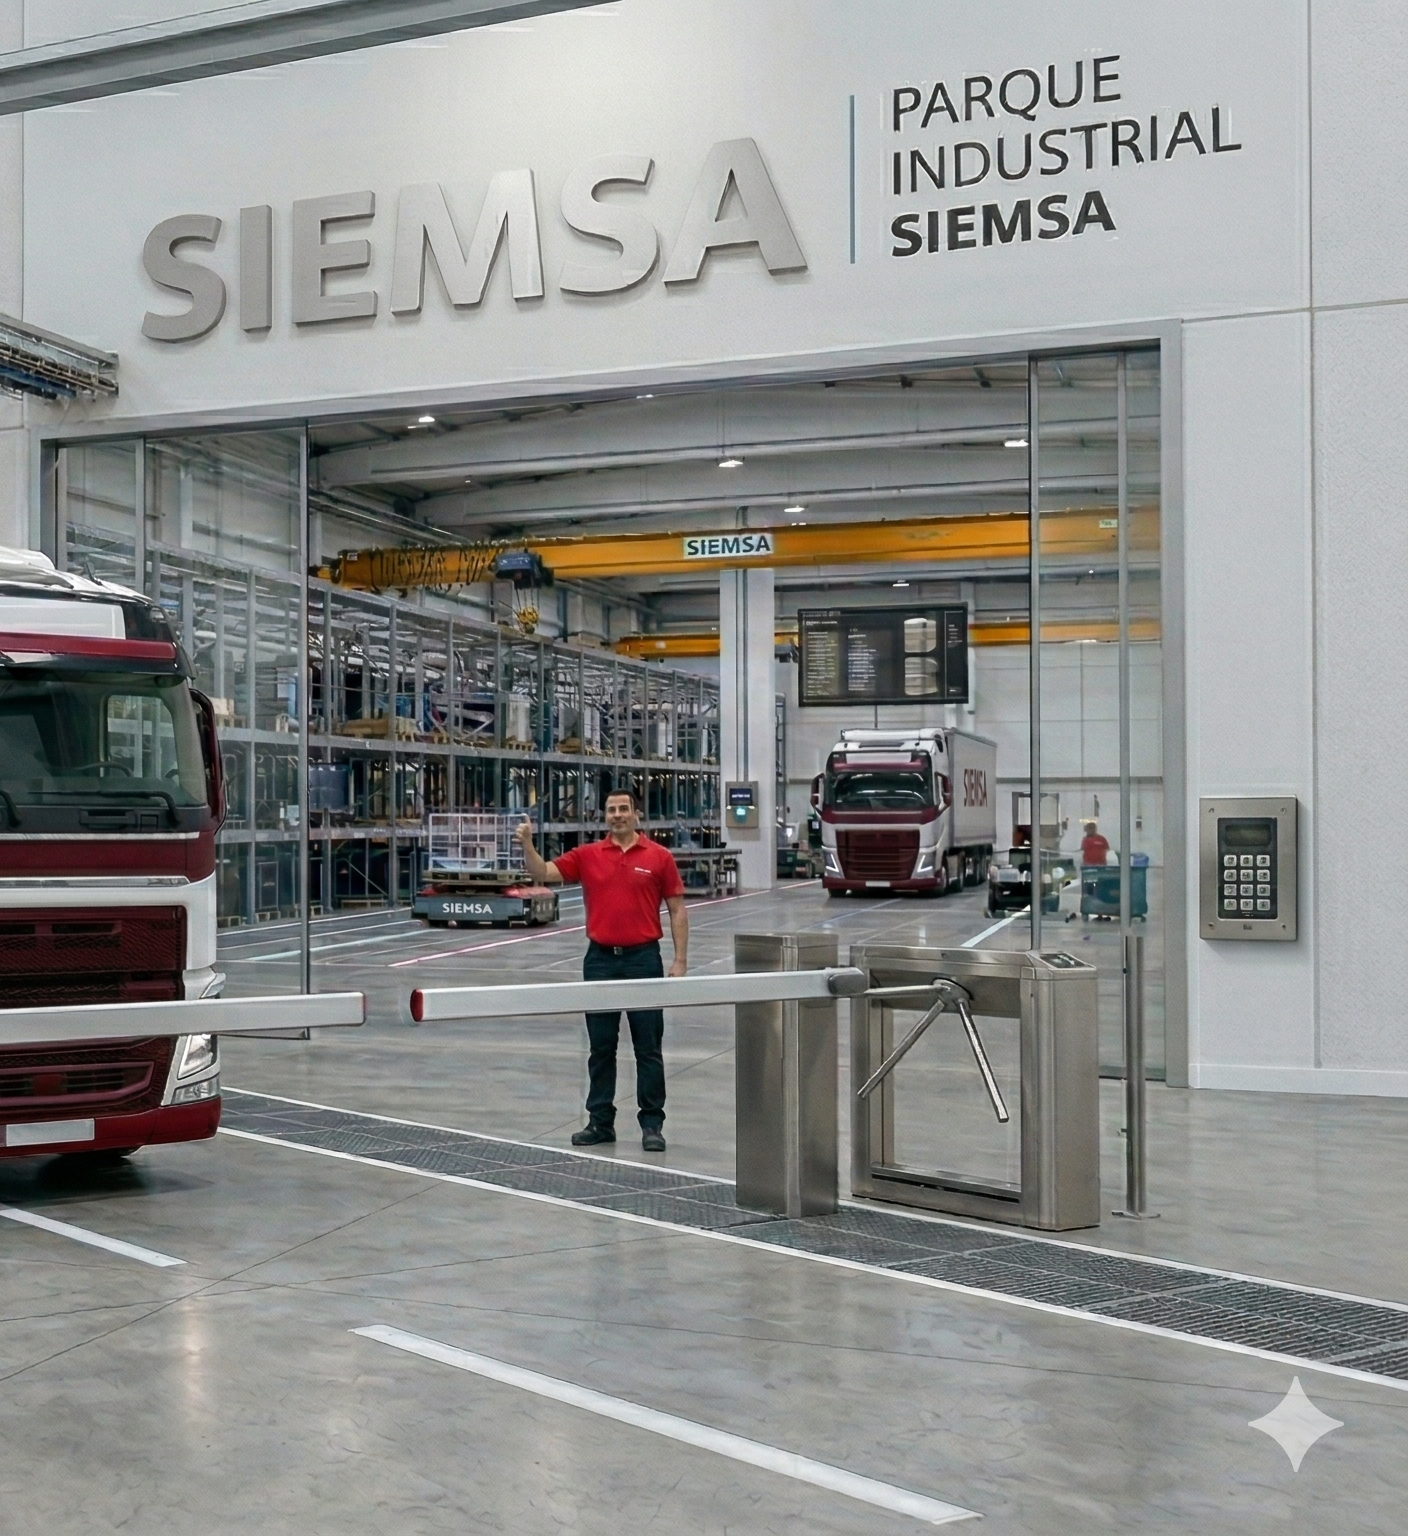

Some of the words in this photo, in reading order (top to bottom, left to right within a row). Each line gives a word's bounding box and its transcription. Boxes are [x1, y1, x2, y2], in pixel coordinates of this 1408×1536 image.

[892, 55, 1121, 132] PARQUE
[892, 104, 1242, 195] INDUSTRIAL
[140, 138, 810, 344] SIEMSA
[891, 191, 1116, 257] SIEMSA
[687, 535, 770, 555] SIEMSA
[963, 769, 987, 807] SIEMSA
[442, 902, 493, 914] SIEMSA
